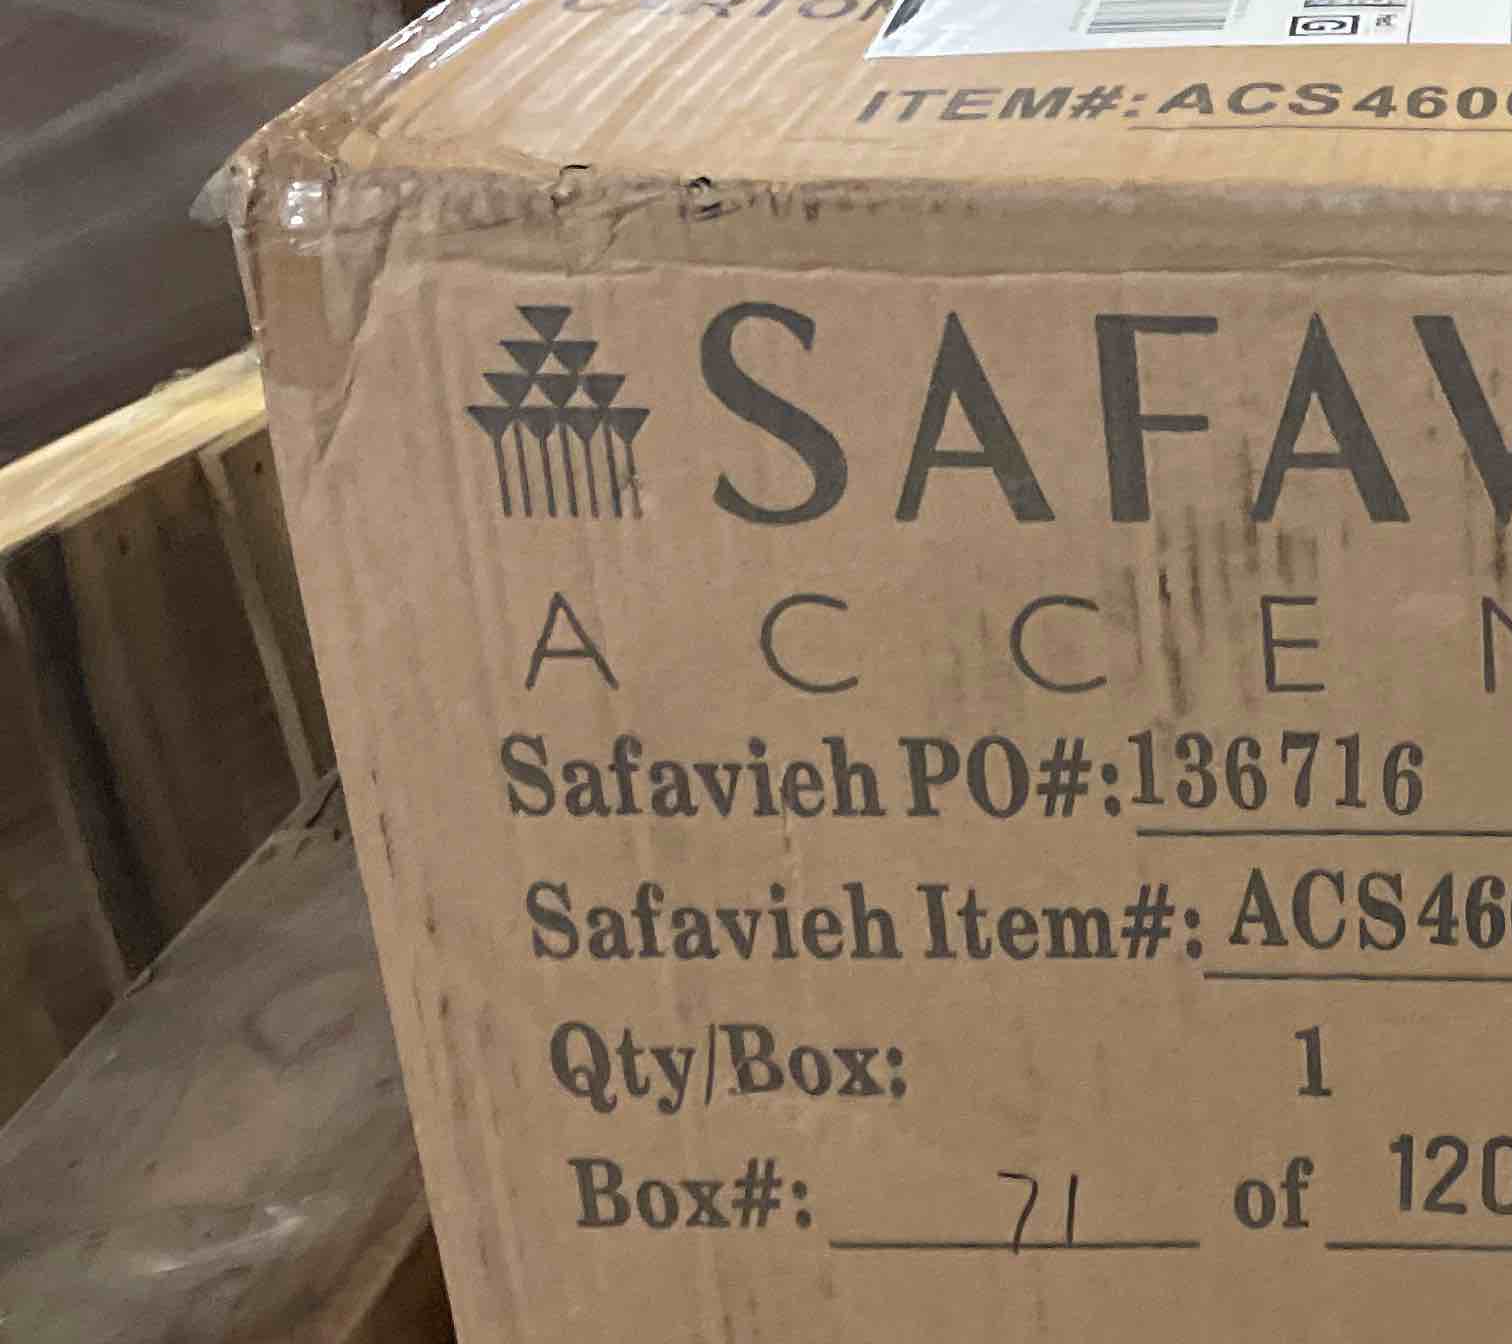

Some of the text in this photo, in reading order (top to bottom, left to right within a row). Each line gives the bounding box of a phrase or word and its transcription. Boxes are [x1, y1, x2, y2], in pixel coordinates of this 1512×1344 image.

[500, 731, 887, 818] Safavieh
[525, 880, 904, 959] Safavieh
[916, 882, 1203, 959] Item#:
[549, 1020, 907, 1114] Qty/Box:
[1295, 1025, 1333, 1097] 1
[568, 1157, 812, 1229] Box#:
[998, 1169, 1079, 1255] 71
[1233, 1156, 1315, 1229] of
